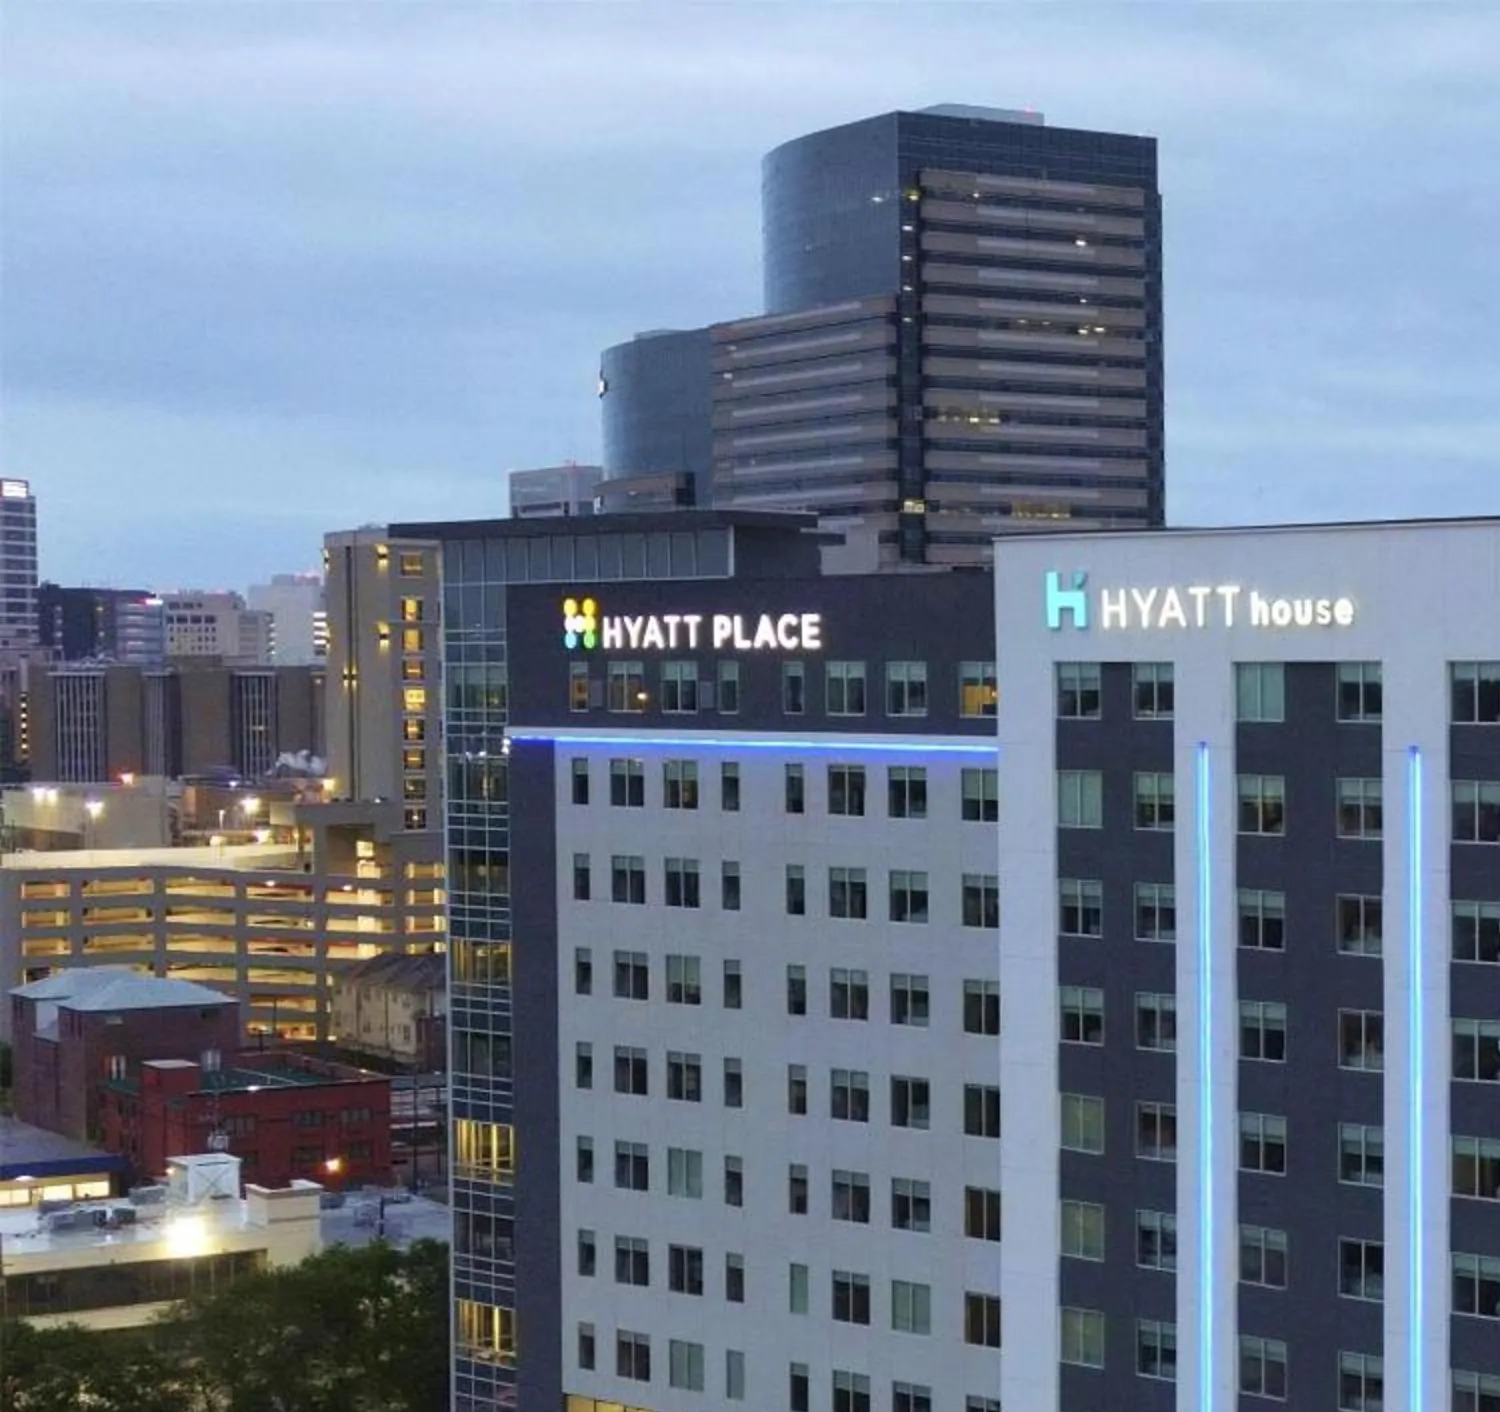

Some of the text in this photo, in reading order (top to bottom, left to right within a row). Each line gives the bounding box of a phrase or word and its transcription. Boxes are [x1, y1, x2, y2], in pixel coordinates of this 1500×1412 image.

[1102, 585, 1241, 629] HYATT
[1250, 590, 1355, 626] house
[602, 614, 702, 650] HYATT
[713, 613, 822, 650] PLACE
